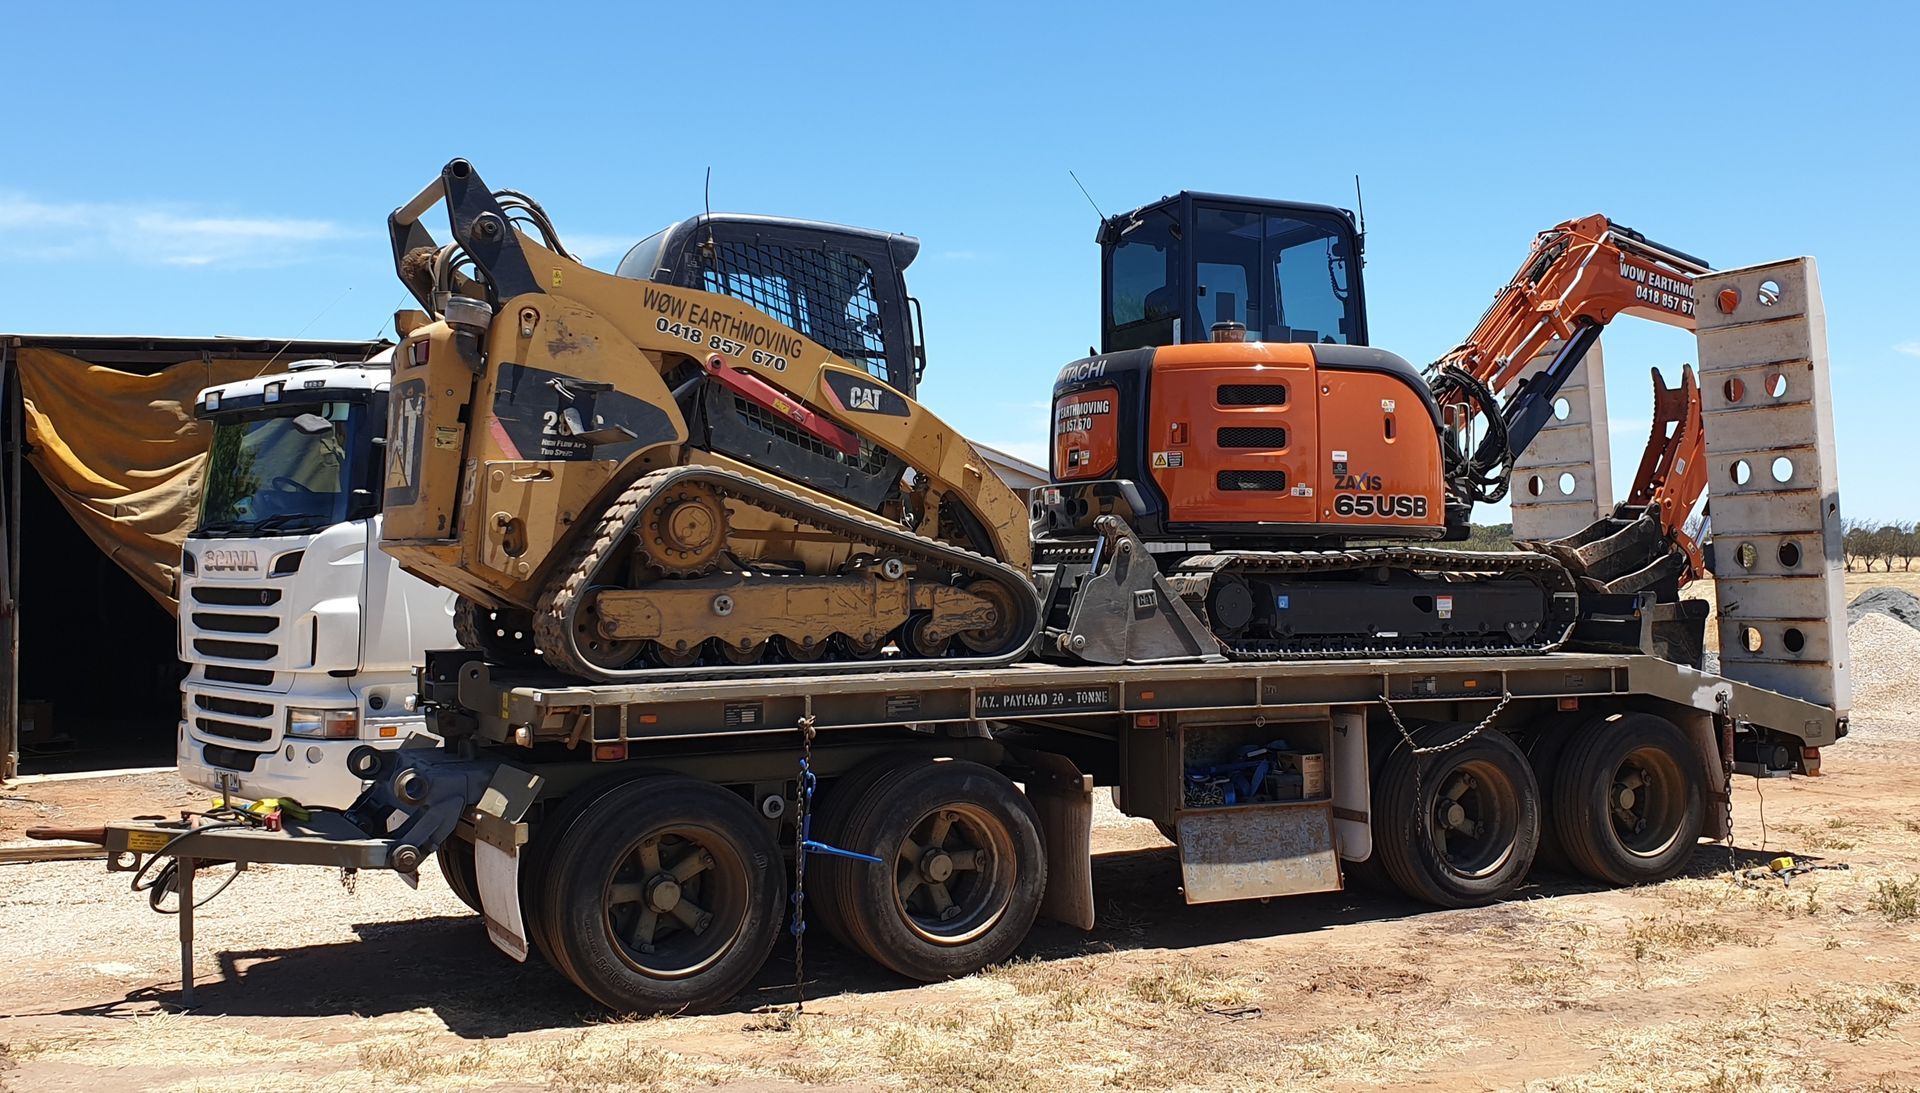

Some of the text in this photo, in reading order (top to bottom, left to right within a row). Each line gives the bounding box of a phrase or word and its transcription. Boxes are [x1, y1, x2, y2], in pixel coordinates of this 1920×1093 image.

[1620, 263, 1646, 283] WOW
[1636, 285, 1659, 304] 0418
[1662, 294, 1679, 310] 857
[688, 303, 803, 358] EARTHMOVING
[656, 318, 787, 372] 0418 857 670
[850, 387, 882, 410] CAT
[1334, 472, 1382, 490] ZAXIS
[1333, 493, 1428, 518] 65USB
[204, 550, 258, 571] SCANIA
[1003, 693, 1048, 707] PAYLOAD
[1052, 693, 1064, 705] 20
[1076, 690, 1108, 704] TONNE
